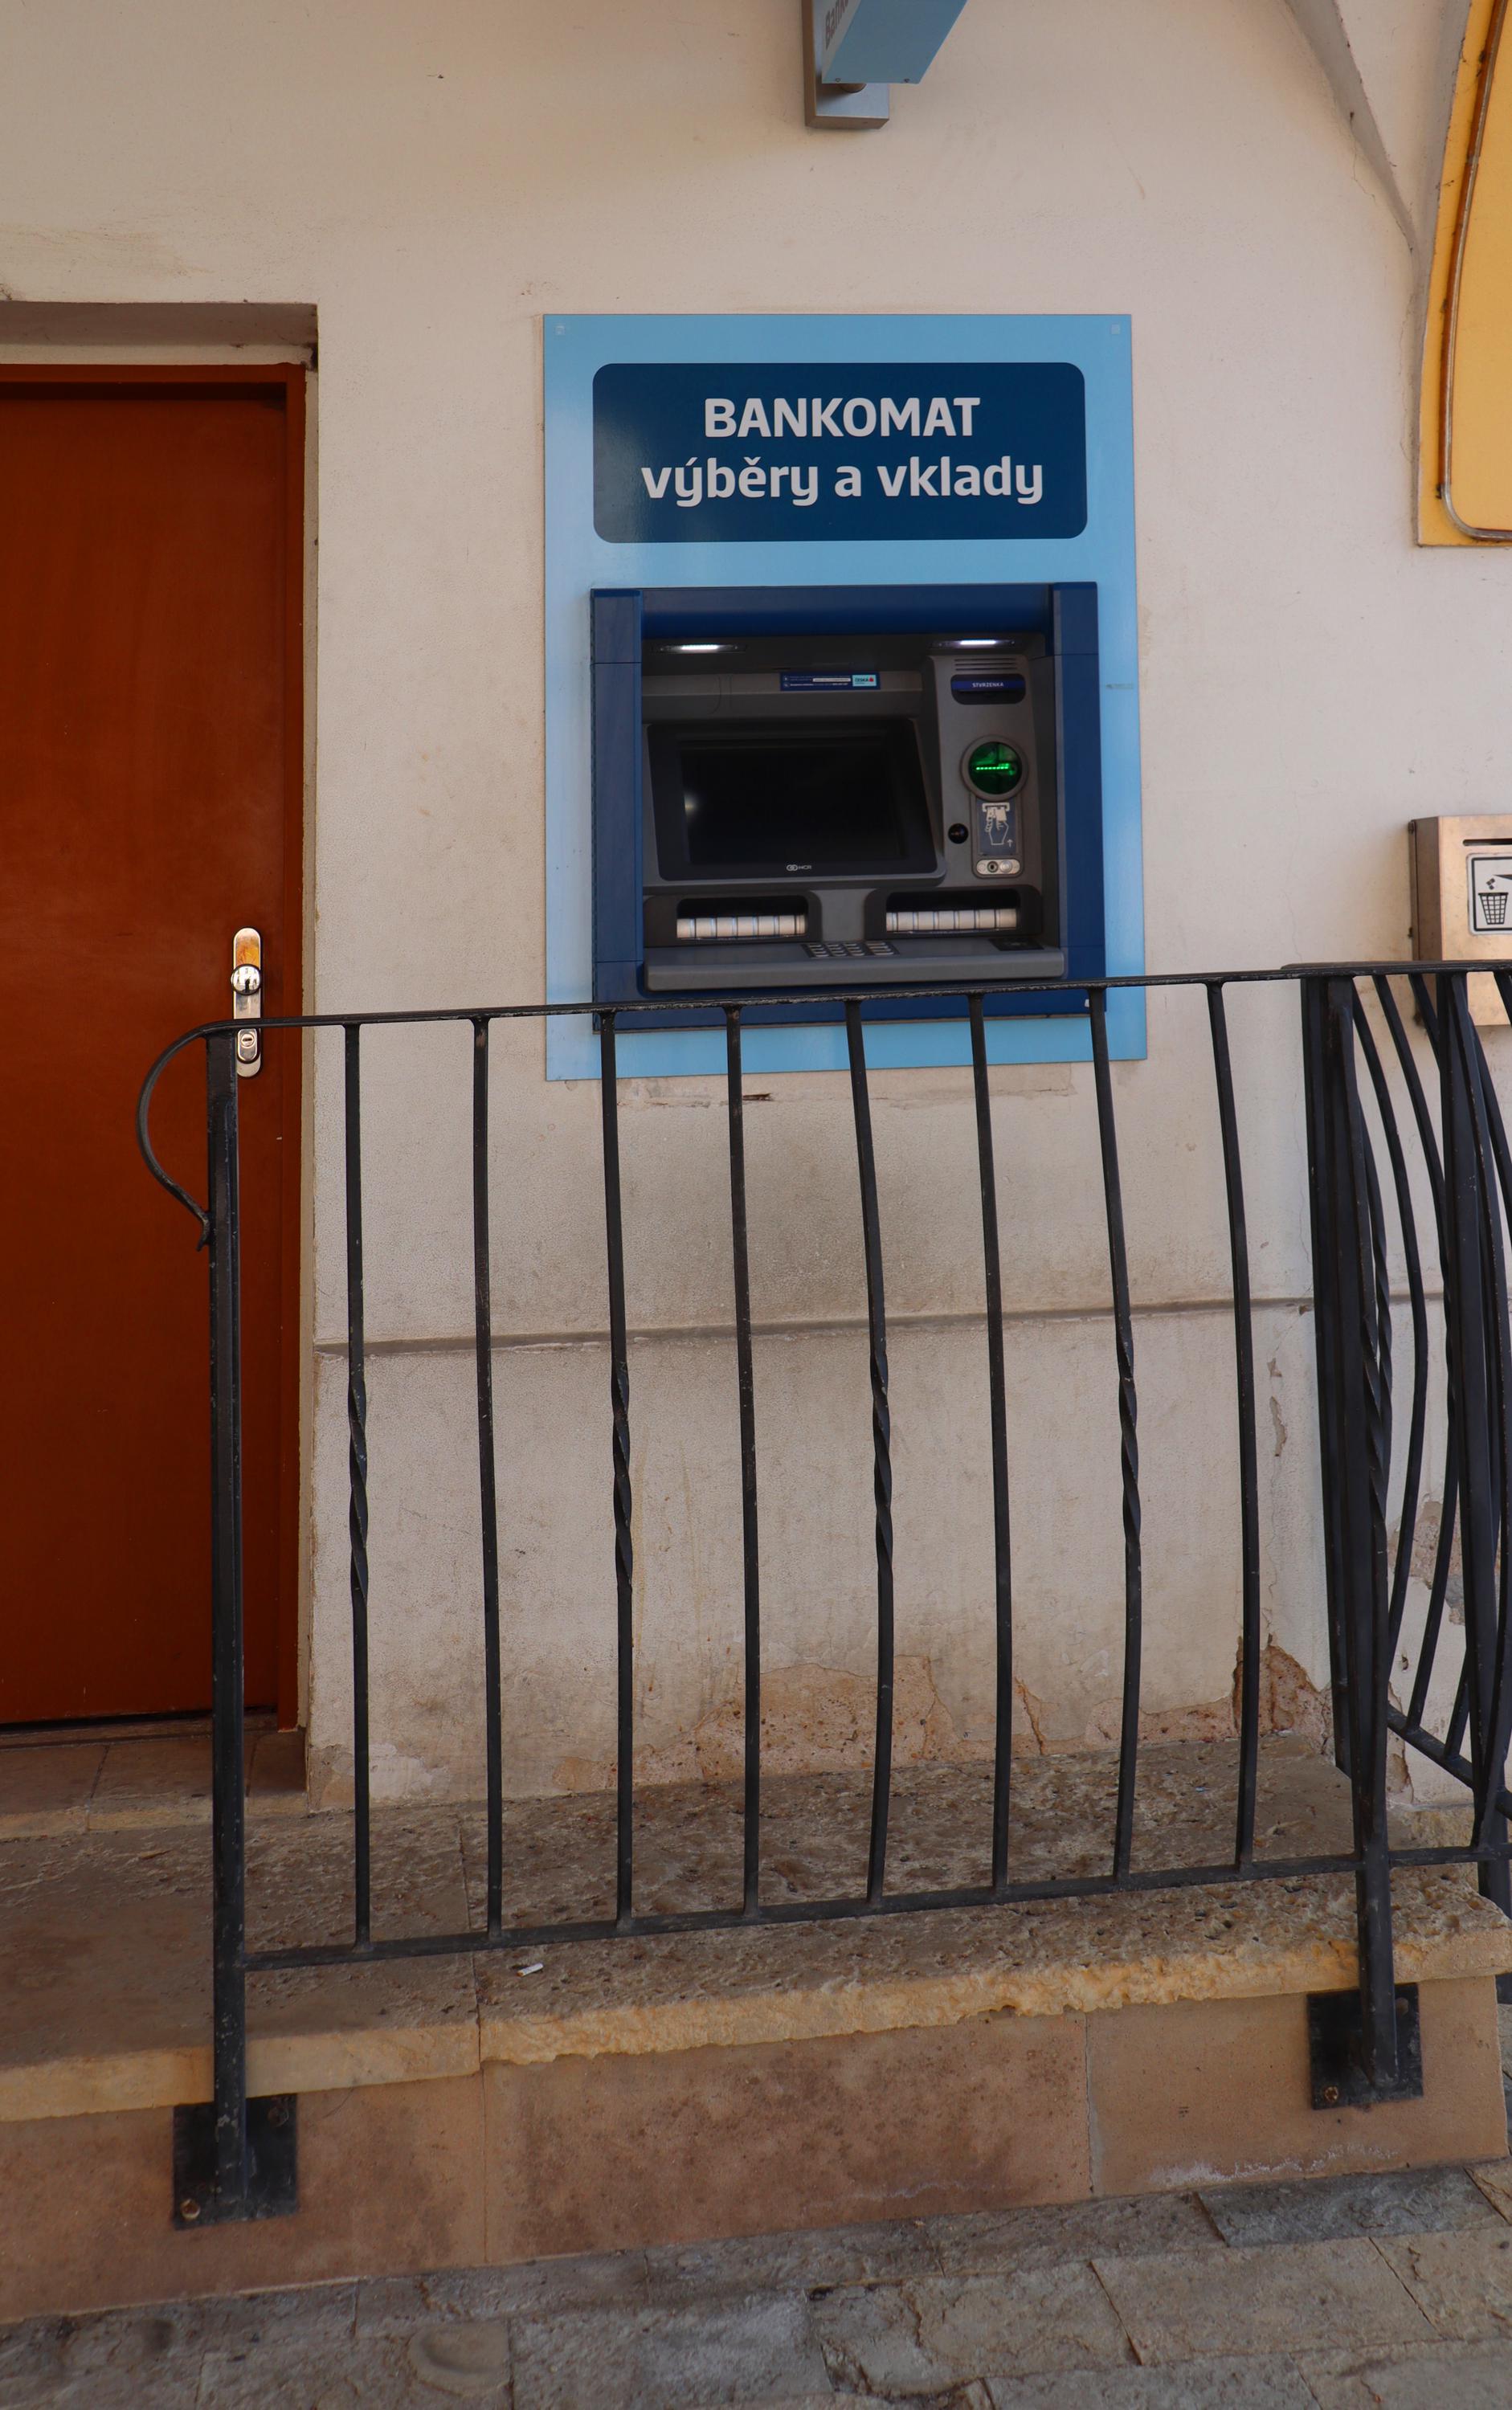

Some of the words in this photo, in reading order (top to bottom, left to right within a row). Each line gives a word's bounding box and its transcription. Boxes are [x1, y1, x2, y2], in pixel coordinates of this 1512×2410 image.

[705, 397, 981, 438] BANKOMAT
[641, 456, 819, 508] výběry
[835, 466, 861, 497] a
[877, 455, 1043, 504] vklady
